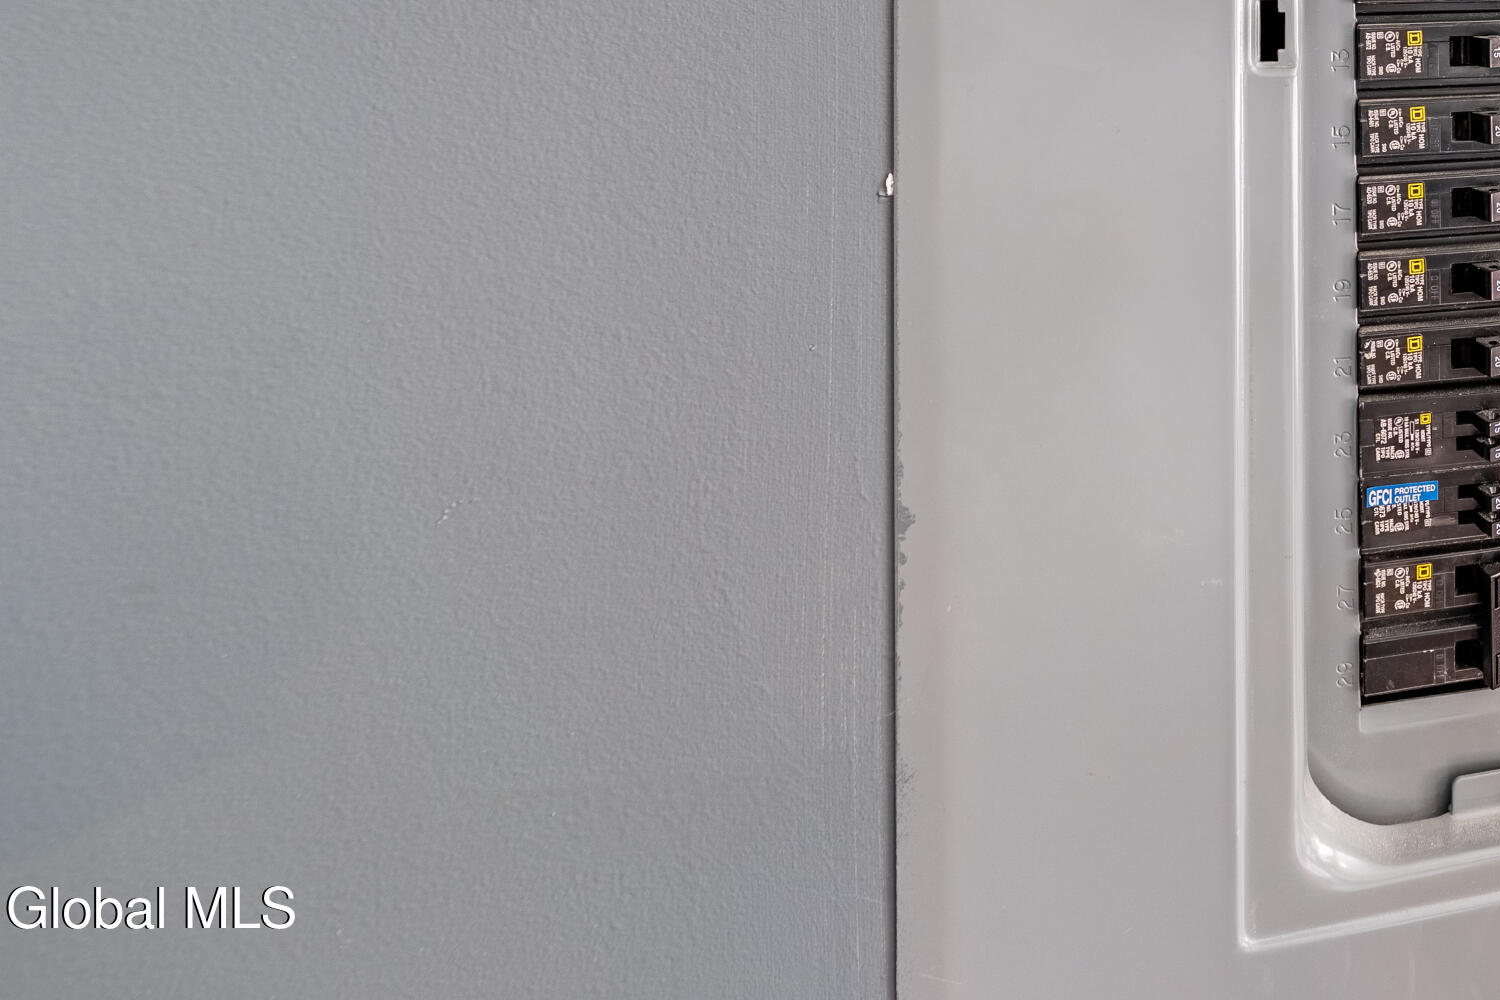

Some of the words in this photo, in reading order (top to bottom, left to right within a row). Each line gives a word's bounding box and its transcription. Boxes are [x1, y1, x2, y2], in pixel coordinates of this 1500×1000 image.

[1332, 124, 1351, 150] 15
[1332, 202, 1352, 226] 17
[1333, 278, 1352, 302] 19
[1368, 488, 1392, 506] GFCI
[1394, 484, 1436, 495] PROTECTED
[1394, 494, 1422, 504] OUTLET
